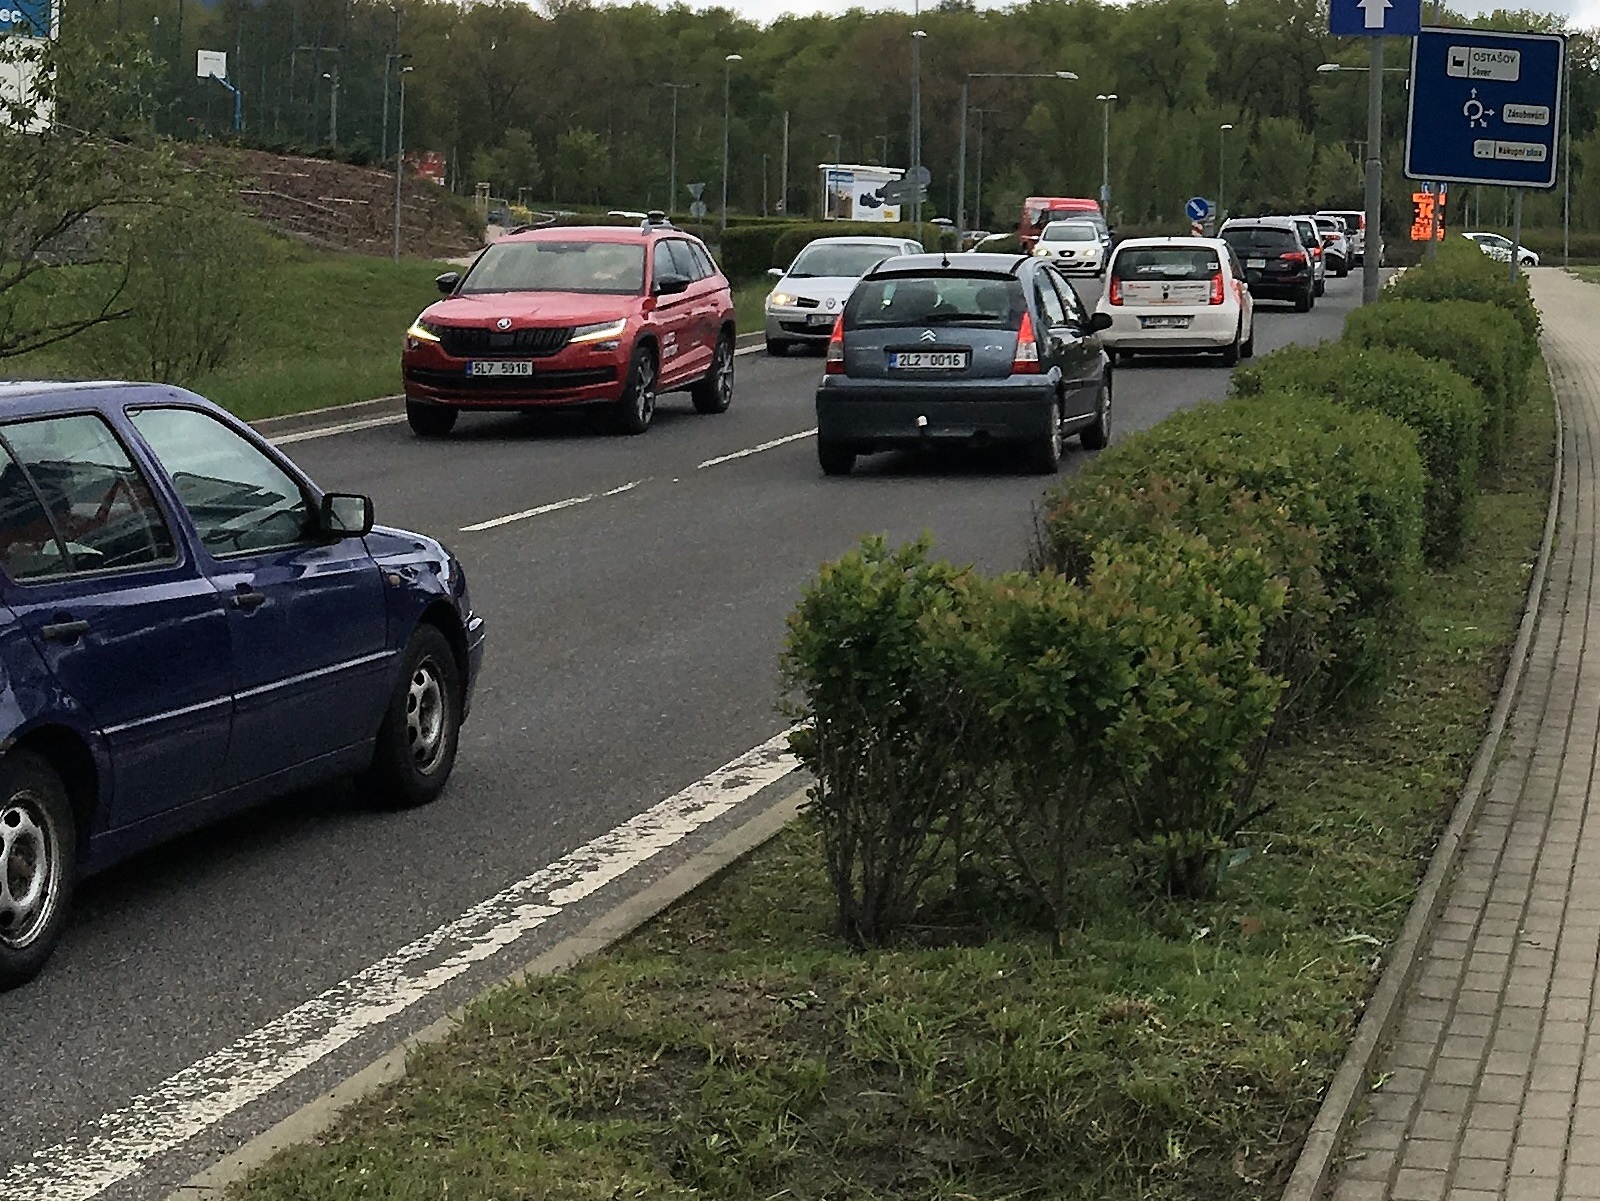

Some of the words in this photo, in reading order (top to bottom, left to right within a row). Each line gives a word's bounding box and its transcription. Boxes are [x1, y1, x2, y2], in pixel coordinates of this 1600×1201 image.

[1472, 52, 1516, 64] OSTAŠOV
[899, 354, 921, 366] 2L2
[930, 354, 961, 366] 0016
[474, 362, 494, 374] 5L7
